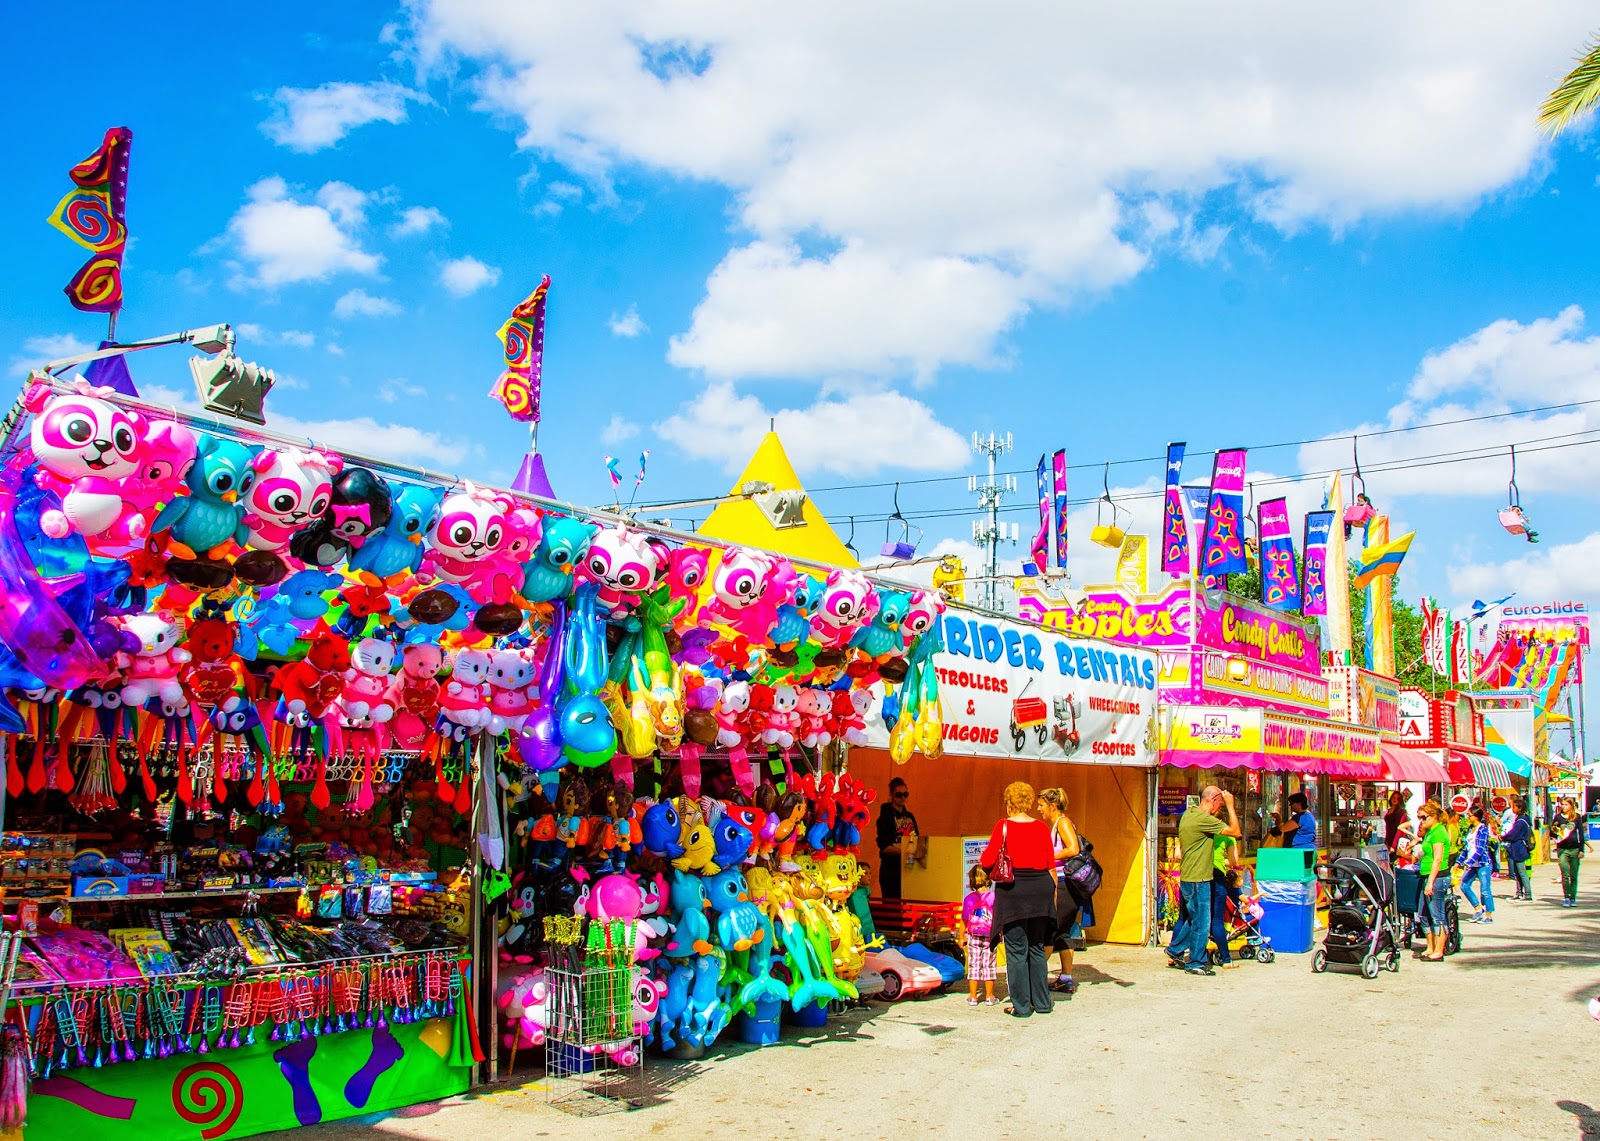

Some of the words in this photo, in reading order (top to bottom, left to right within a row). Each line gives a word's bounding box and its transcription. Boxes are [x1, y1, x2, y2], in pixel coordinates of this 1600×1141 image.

[1085, 600, 1122, 615] Candy
[1503, 600, 1585, 615] euroslide
[1041, 606, 1176, 638] Apples
[1221, 607, 1266, 660] Candy
[1268, 622, 1305, 658] Castle
[1435, 616, 1444, 672] PIZZA
[1054, 641, 1155, 690] RENTALS
[1206, 655, 1228, 681] CANDY
[1256, 667, 1271, 690] COLD
[1272, 671, 1293, 694] DRINKS
[1297, 677, 1326, 703] POPCORN
[965, 699, 975, 715] &
[1089, 696, 1140, 715] WHEELCHAIRS
[1092, 741, 1136, 756] SCOOTERS
[1288, 727, 1306, 751] CANDY
